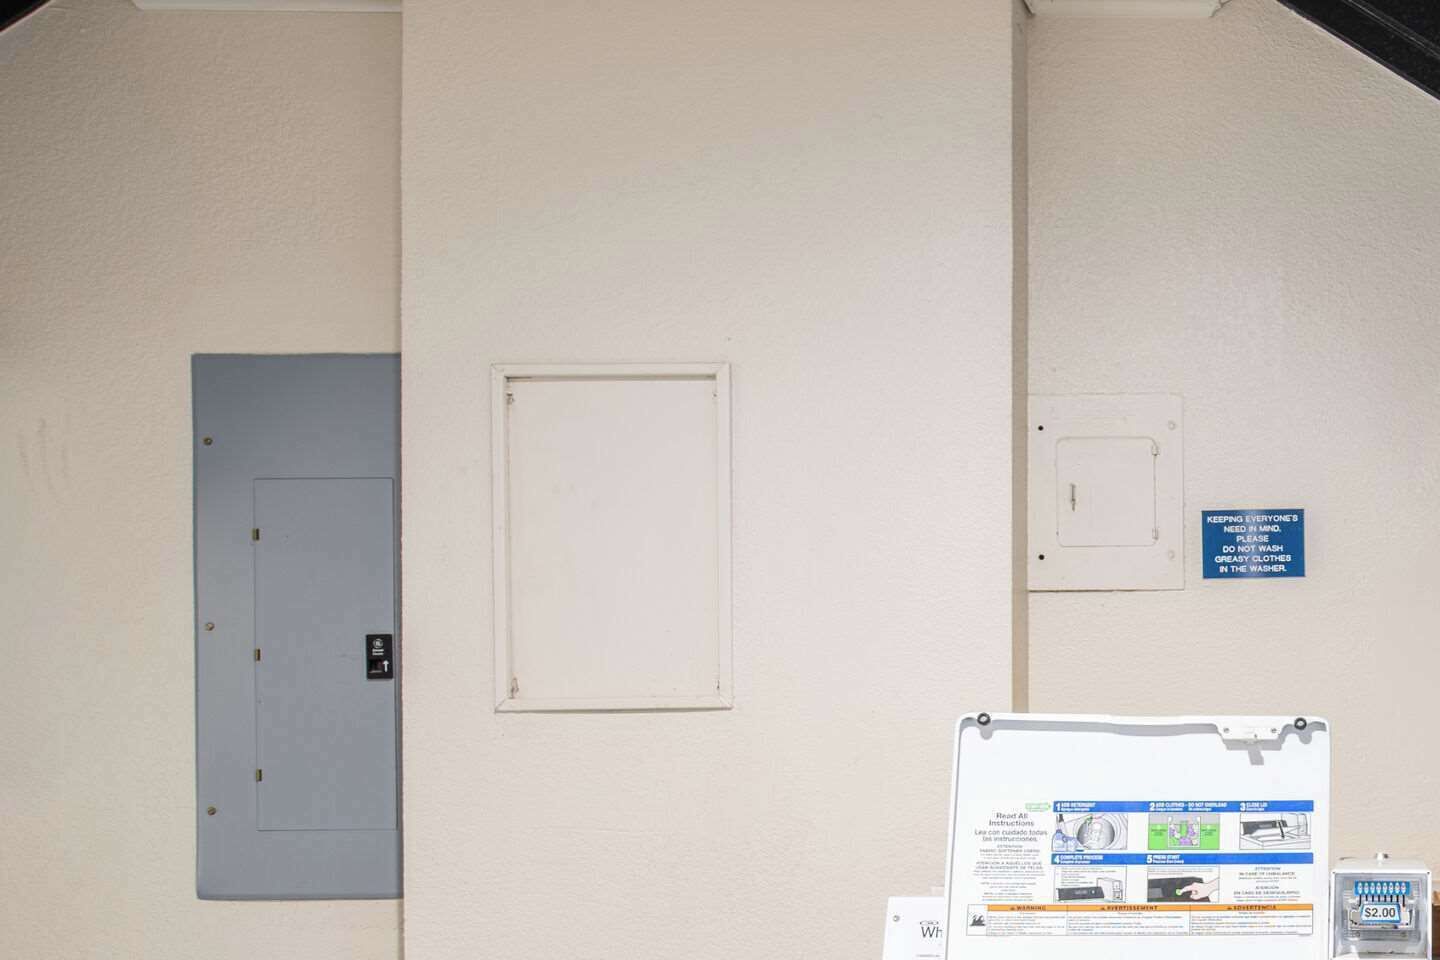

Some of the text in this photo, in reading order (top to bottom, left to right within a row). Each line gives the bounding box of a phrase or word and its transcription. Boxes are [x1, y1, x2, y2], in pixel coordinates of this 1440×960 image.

[1245, 514, 1298, 522] EVERYONE'S
[1224, 525, 1246, 533] NEED
[1222, 545, 1235, 553] DO
[1214, 554, 1291, 563] GREASY CLOTHES
[1219, 564, 1287, 573] IN THE WASHER.
[1364, 907, 1396, 918] $2.00
